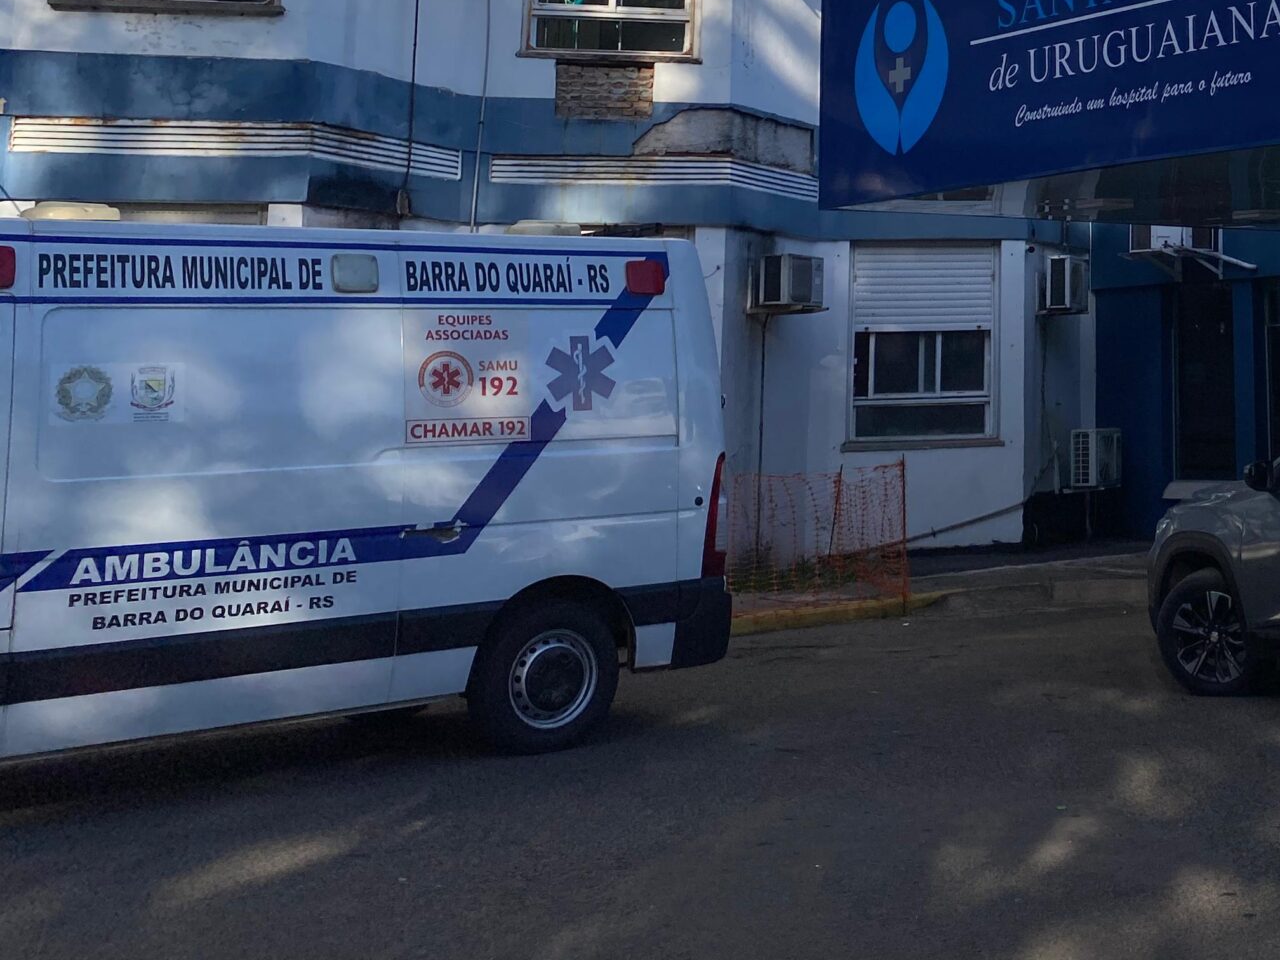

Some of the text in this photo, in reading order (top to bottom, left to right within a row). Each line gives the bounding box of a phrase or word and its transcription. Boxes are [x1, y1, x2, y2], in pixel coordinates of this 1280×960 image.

[989, 53, 1019, 91] de
[1015, 70, 1252, 127] Construindo um hospital para o futuro
[38, 253, 176, 289] PREFEITURA
[182, 256, 292, 290] MUNICIPAL
[299, 258, 323, 290] DE
[405, 260, 470, 292] BARRA
[474, 262, 500, 292] DO
[506, 257, 573, 295] QUARAÍ
[587, 264, 609, 293] RS
[425, 329, 509, 341] ASSOCIADAS
[438, 315, 492, 327] EQUIPES
[479, 360, 518, 371] SAMU
[479, 376, 518, 396] 192
[410, 420, 526, 439] CHAMAR 192
[69, 537, 357, 585] AMBULÂNCIA
[68, 570, 357, 608] PREFEITURA MUNICIPAL DE
[92, 611, 168, 630] BARRA
[175, 607, 204, 622] DO
[211, 596, 290, 619] QUARAÍ
[308, 595, 334, 610] RS
